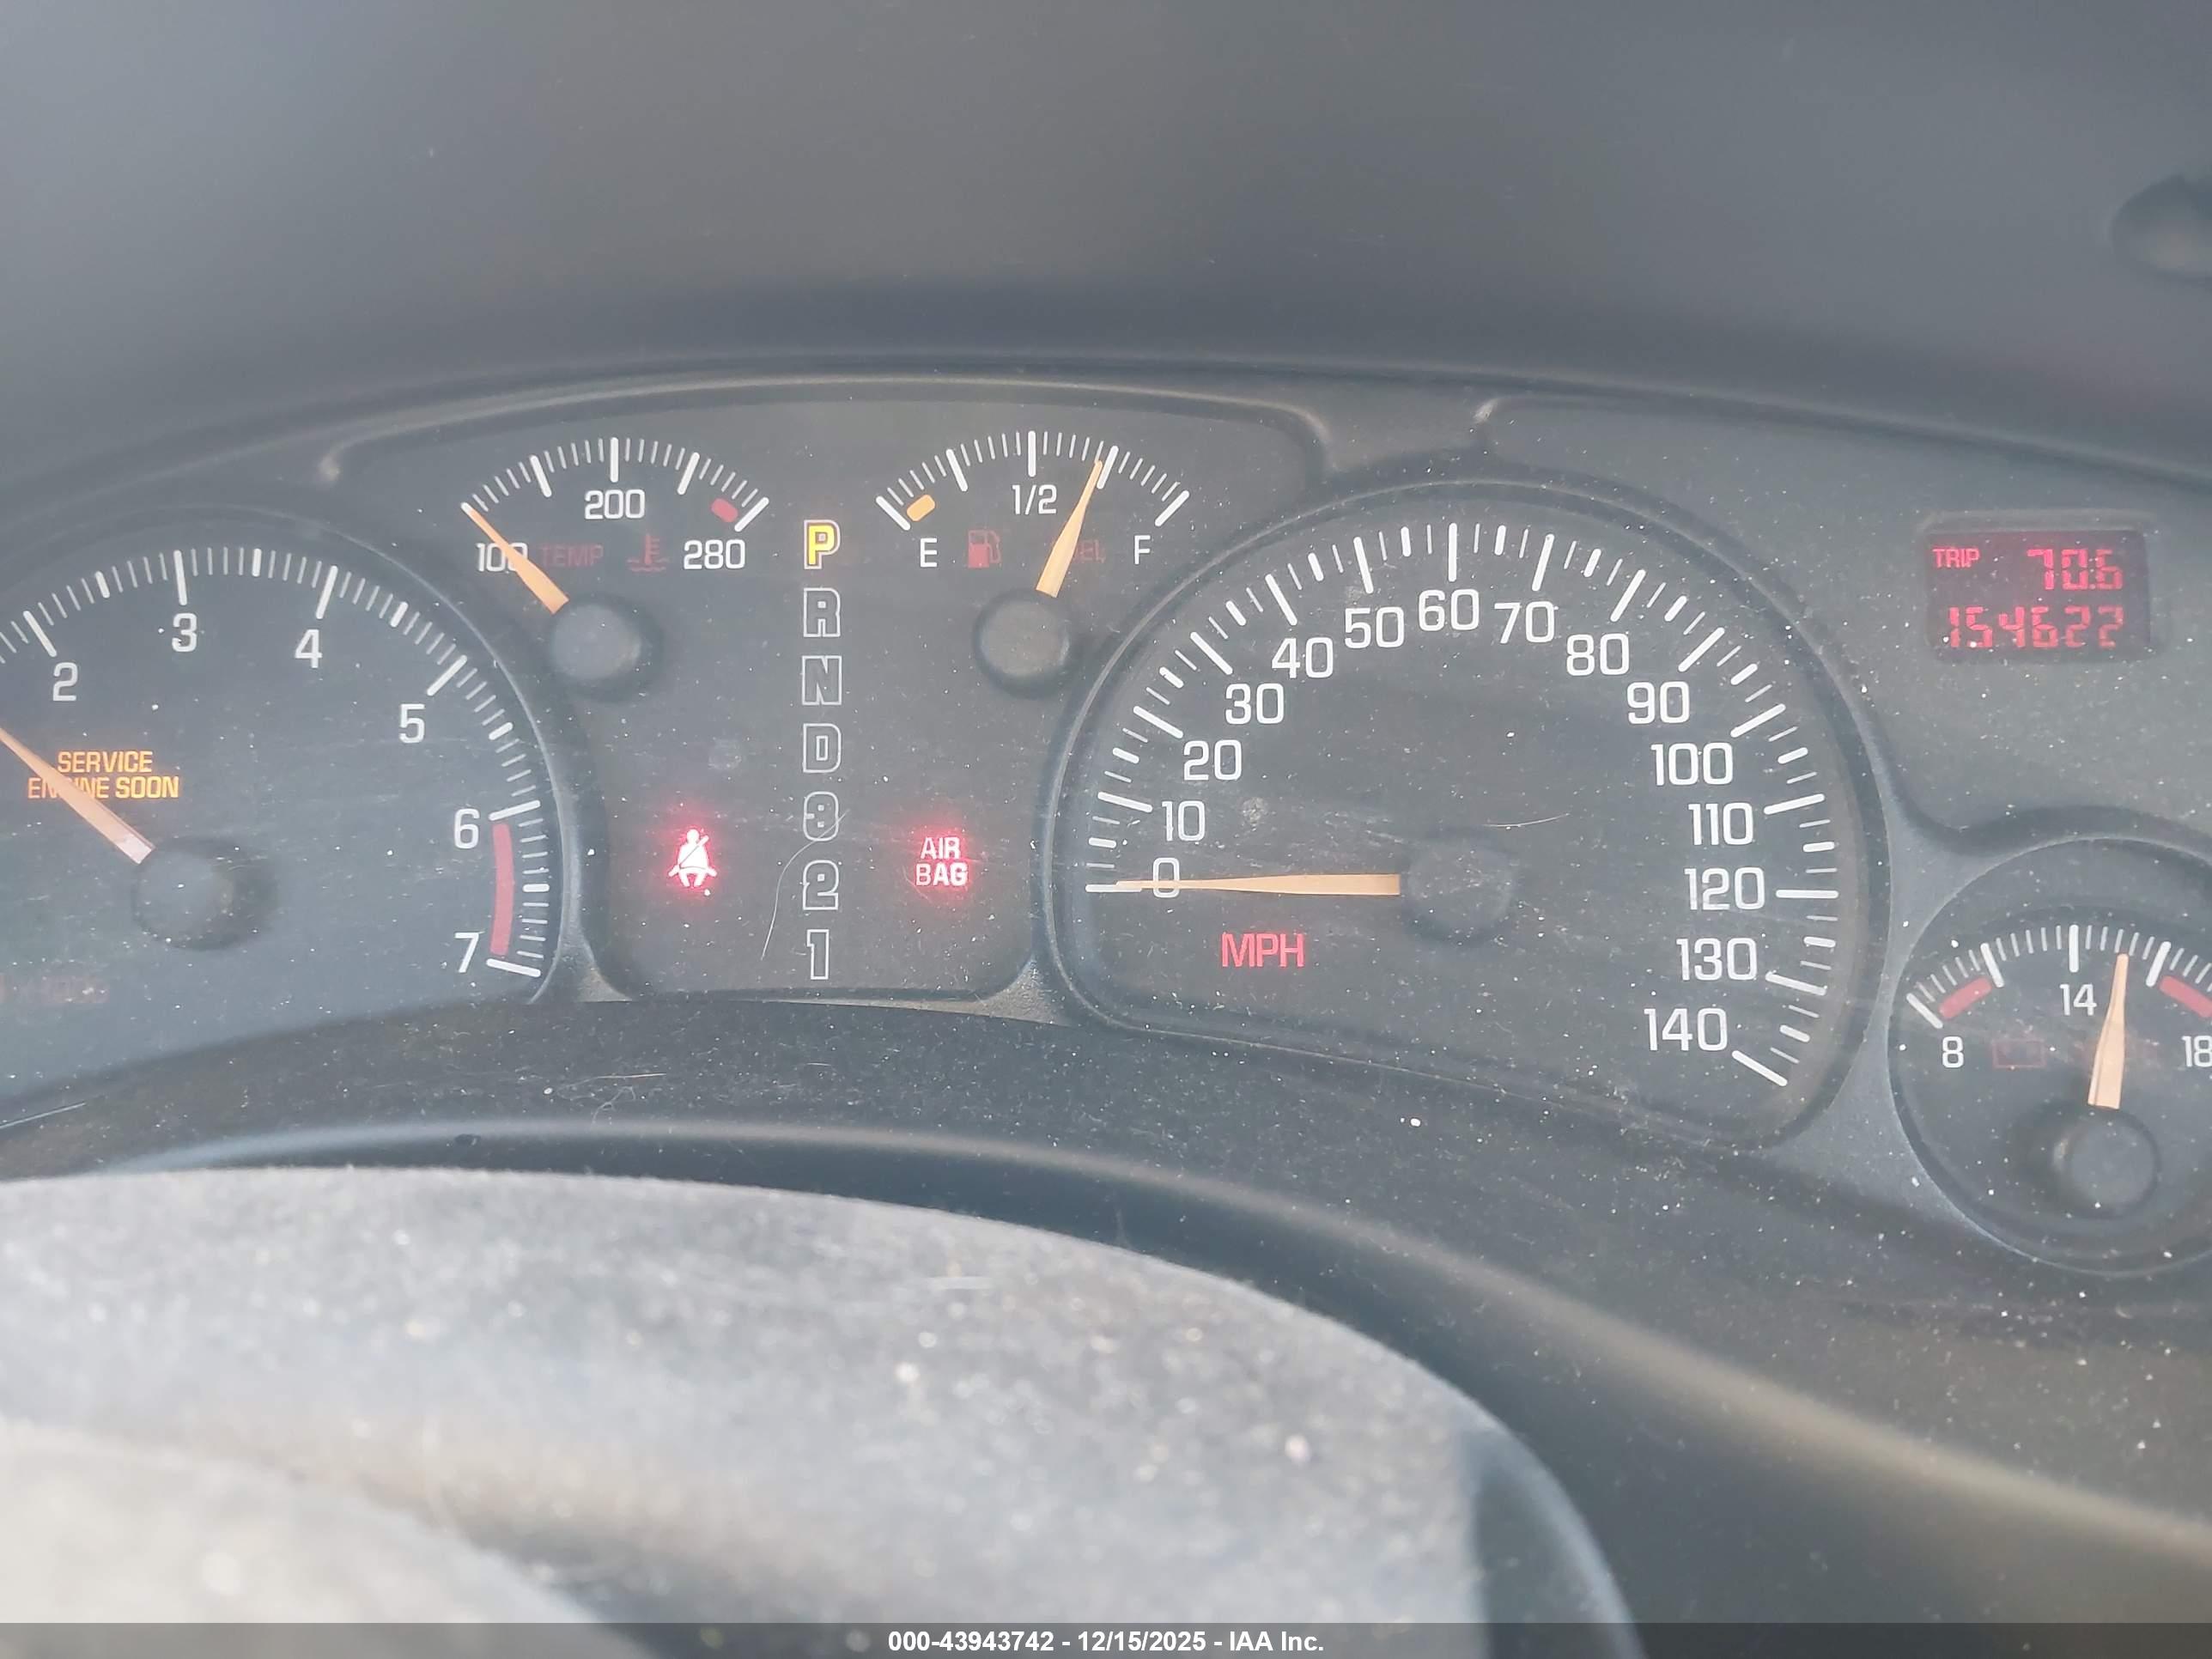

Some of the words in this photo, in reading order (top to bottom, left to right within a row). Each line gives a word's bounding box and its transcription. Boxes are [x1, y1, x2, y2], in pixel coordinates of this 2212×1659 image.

[585, 489, 645, 520] 200
[1012, 484, 1057, 515] 1/2
[684, 539, 745, 569] 280
[804, 520, 840, 569] P
[920, 538, 938, 567] E
[1133, 535, 1151, 564] F
[1932, 547, 1980, 568] TRIP
[803, 587, 841, 637] R
[1345, 606, 1405, 648] 50
[1419, 589, 1479, 630] 60
[1494, 601, 1554, 643] 70
[1948, 605, 2124, 648] 154622
[172, 612, 198, 653] 3
[295, 629, 323, 669] 4
[1271, 637, 1334, 678] 40
[1566, 634, 1630, 676] 80
[52, 661, 78, 702] 2
[801, 655, 842, 705] N
[399, 704, 425, 744] 5
[1225, 684, 1285, 725] 30
[1627, 682, 1690, 725] 90
[57, 750, 154, 773] SERVICE
[803, 723, 841, 773] D
[1183, 739, 1243, 781] 20
[1651, 743, 1734, 786] 100
[27, 776, 111, 799] ENNE
[115, 775, 179, 799] SOON
[453, 809, 480, 848] 6
[1162, 800, 1206, 842] 10
[1687, 803, 1753, 846] 110
[920, 836, 961, 860] AIR
[802, 860, 839, 910] 2
[915, 861, 969, 886] BAG
[1152, 858, 1181, 898] 0
[1684, 867, 1765, 910] 120
[454, 932, 483, 973] 7
[807, 928, 830, 980] 1
[1221, 933, 1305, 968] MPH
[1677, 938, 1758, 981] 130
[2060, 984, 2098, 1016] 14
[1644, 1008, 1728, 1051] 140
[1942, 1036, 1964, 1068] 8
[2181, 1036, 2212, 1067] 18
